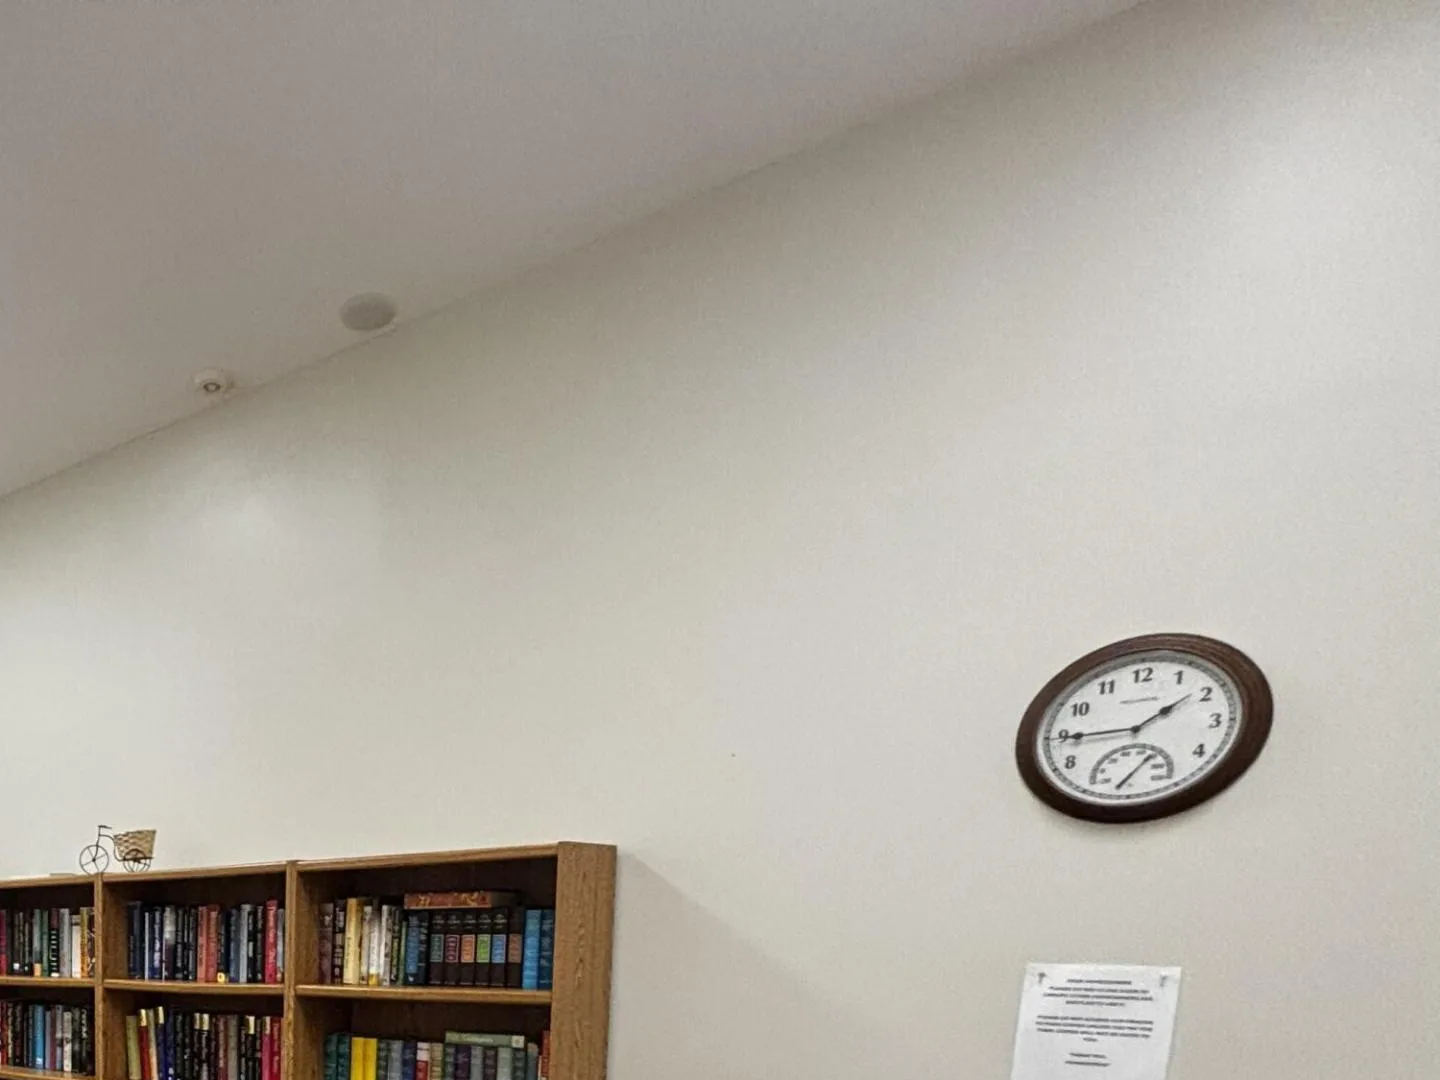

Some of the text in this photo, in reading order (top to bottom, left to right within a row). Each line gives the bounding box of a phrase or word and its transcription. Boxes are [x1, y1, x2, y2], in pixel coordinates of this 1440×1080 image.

[1132, 667, 1153, 683] 12
[1173, 670, 1185, 685] 1
[1098, 680, 1116, 695] 11
[1199, 687, 1213, 702] 2
[1071, 702, 1090, 717] 10
[1209, 713, 1222, 728] 3
[1058, 729, 1069, 743] 9
[1192, 743, 1206, 758] 4
[1064, 755, 1076, 769] 8
